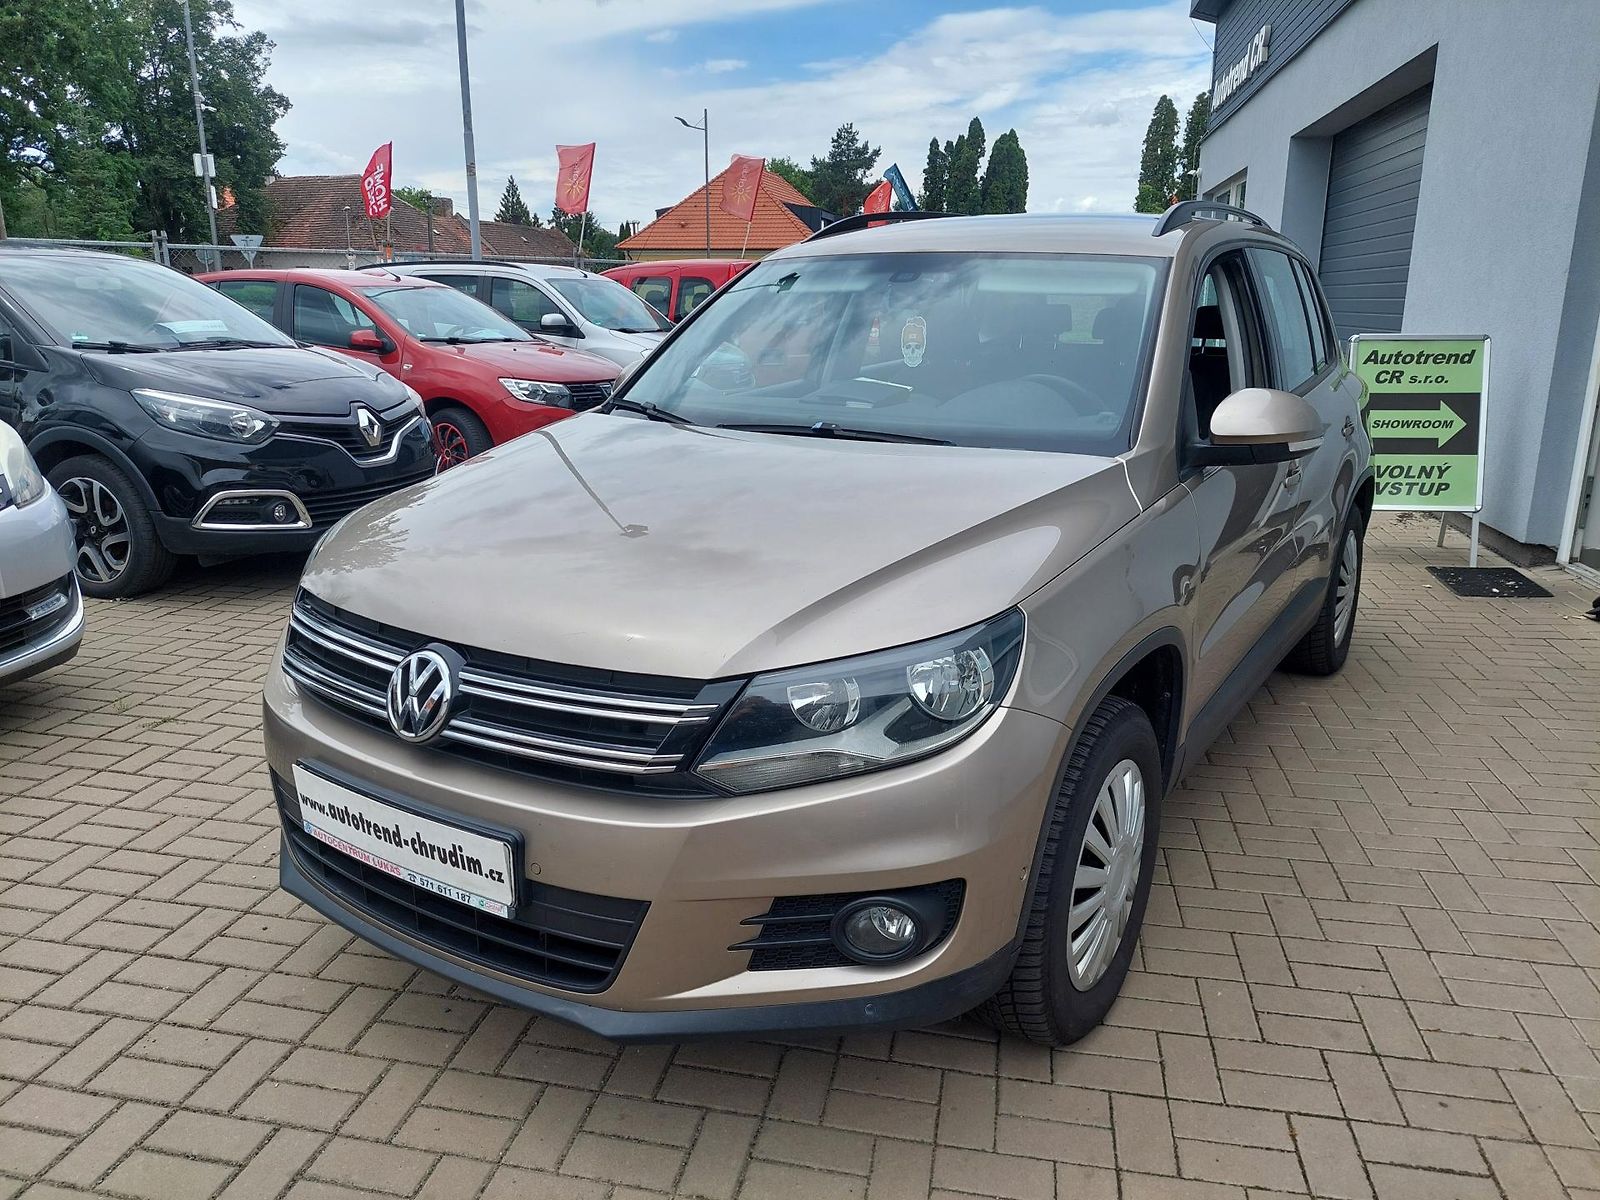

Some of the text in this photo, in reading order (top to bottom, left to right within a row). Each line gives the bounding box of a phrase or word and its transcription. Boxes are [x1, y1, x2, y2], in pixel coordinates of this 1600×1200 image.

[1363, 350, 1477, 365] Autotrend
[1375, 370, 1449, 384] CR s.r.o.
[1372, 420, 1454, 429] SHOWROOM
[1375, 462, 1452, 479] VOLNÝ
[1375, 482, 1451, 496] VSTUP
[299, 792, 505, 884] www.autotrend-chrudim.cz
[313, 830, 370, 862] AUTOCENTRUM
[420, 877, 471, 903] 571 611 187
